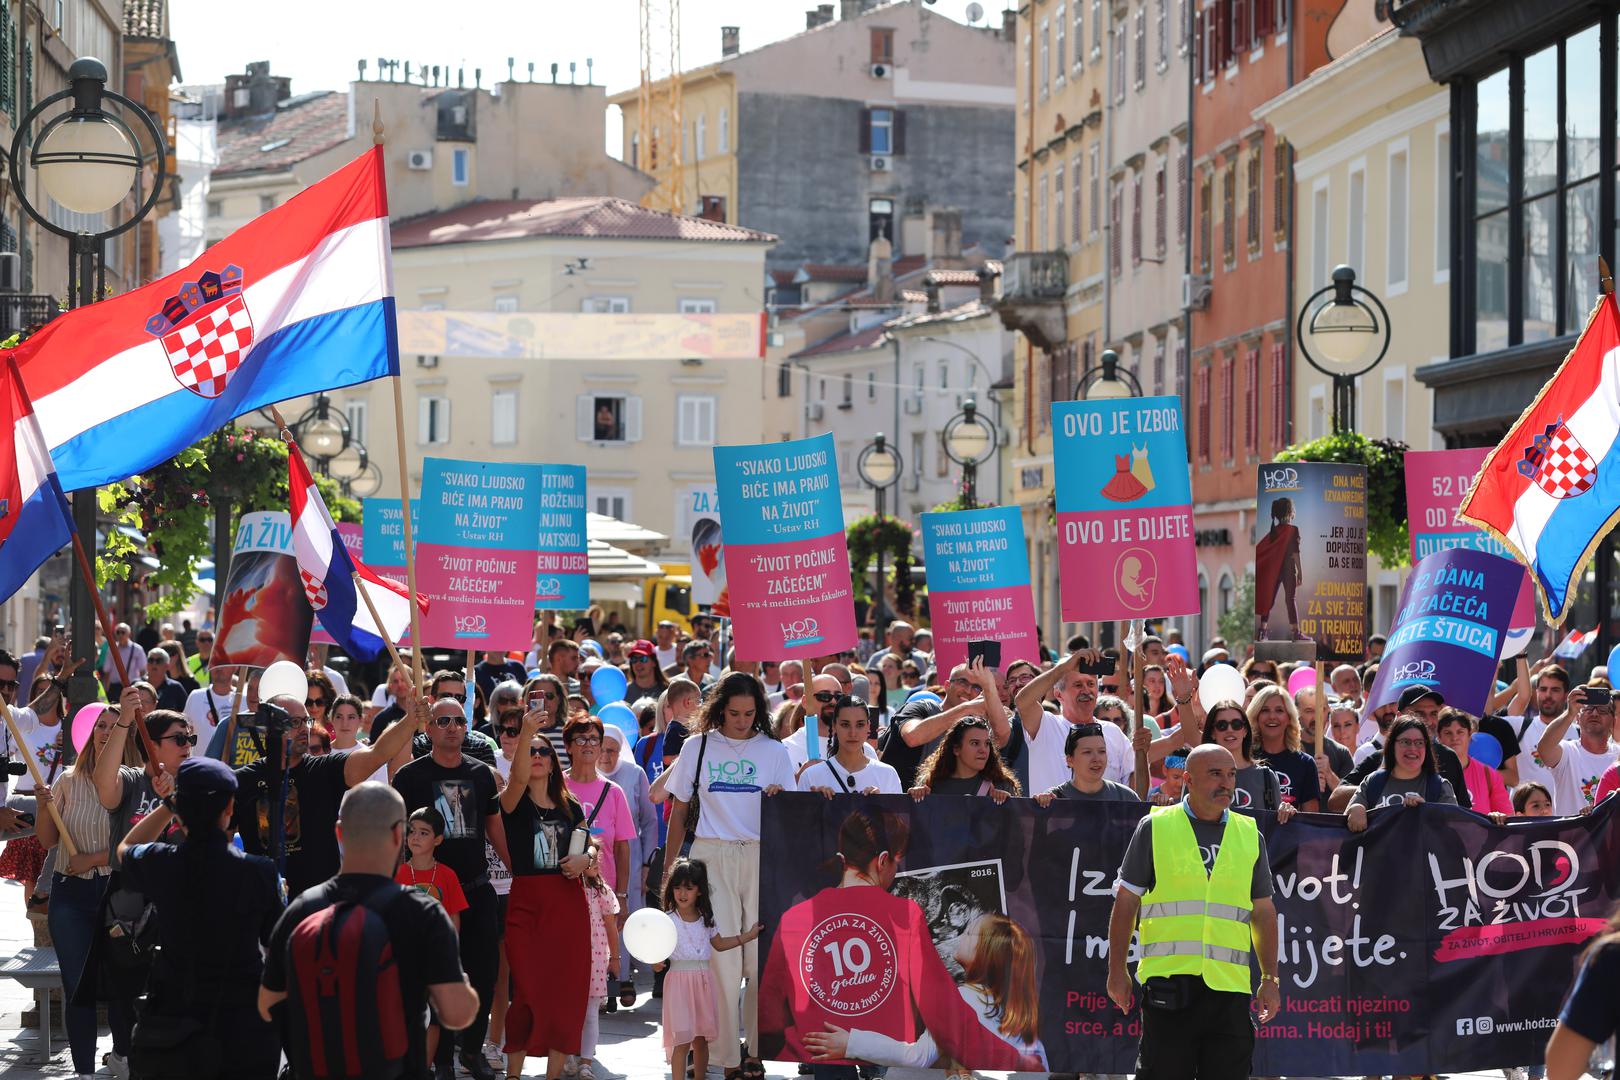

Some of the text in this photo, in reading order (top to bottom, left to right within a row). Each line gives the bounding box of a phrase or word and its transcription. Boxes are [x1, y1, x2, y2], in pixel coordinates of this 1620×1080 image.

[1063, 408, 1179, 437] OVO JE IZBOR
[736, 450, 827, 476] “SVAKO LJUDSKO
[440, 472, 526, 491] “SVAKO LJUDSKO
[1263, 467, 1298, 483] HOD
[1333, 475, 1348, 488] ONA
[742, 473, 829, 499] BIĆE IMA PRAVO
[1432, 476, 1453, 497] 52
[442, 491, 524, 510] BIĆE IMA PRAVO
[692, 492, 709, 512] ZA
[762, 499, 820, 520] NA ŽIVOT”
[455, 511, 508, 529] NA ŽIVOT”
[540, 513, 572, 528] NJINU
[773, 522, 802, 534] Ustav
[804, 519, 820, 531] RH
[964, 519, 1007, 535] LJUDSKO
[1425, 507, 1447, 528] OD
[234, 516, 295, 552] ZA ŽIV
[380, 522, 400, 535] BIĆE
[462, 530, 486, 541] Ustav
[488, 531, 504, 541] RH
[1065, 520, 1105, 545] OVO
[1110, 518, 1133, 543] JE
[1138, 515, 1190, 540] DIJETE
[1330, 526, 1344, 538] JER
[1345, 527, 1357, 539] JOJ
[539, 532, 580, 547] VATSKOJ
[936, 538, 1008, 555] BIĆE IMA PRAVO
[438, 555, 517, 574] “ŽIVOT POČINJE
[538, 555, 588, 571] ENU DJECU
[750, 547, 836, 572] “ŽIVOT POČINJE
[949, 561, 961, 573] NA
[1328, 556, 1339, 569] DA
[1341, 556, 1350, 569] SE
[956, 575, 977, 584] Ustav
[979, 573, 994, 583] RH
[1411, 567, 1485, 594] 52 DANA
[762, 599, 767, 608] 4
[769, 594, 820, 608] medicinska
[821, 589, 848, 602] fakulteta
[1314, 581, 1364, 598] JEDNAKOST
[448, 595, 493, 605] medicinska
[493, 596, 525, 606] fakulteta
[972, 597, 1013, 613] POČINJE
[1308, 597, 1364, 617] ZA SVE ŽENE
[1397, 591, 1488, 625] OD ZAČEĆA
[454, 615, 486, 628] HOD
[780, 617, 818, 635] HOD
[1300, 619, 1364, 635] OD TRENUTKA
[784, 633, 795, 641] ZA
[995, 631, 1028, 641] fakulteta
[1432, 617, 1492, 651] ŠTUCA
[1335, 636, 1364, 655] ZAČEĆA
[1393, 660, 1436, 678] HOD
[708, 758, 757, 776] HOD
[971, 868, 996, 878] 2016.
[1068, 846, 1119, 902] Iz
[1428, 840, 1580, 909] HOD
[1436, 886, 1590, 931] ZA ŽIVOT
[805, 917, 891, 972] GENERACIJA ZA ŽIVOT
[1448, 939, 1462, 951] ZA
[1493, 932, 1531, 944] OBITELJ
[1532, 931, 1537, 940] I
[1538, 923, 1587, 938] HRVATSKU
[823, 937, 871, 977] 10
[809, 966, 893, 1011] 2016. HOD ZA ŽIVOT 2025.
[831, 971, 877, 996] godina
[1066, 991, 1108, 1012] Prije
[1286, 995, 1341, 1013] kucati
[1347, 995, 1411, 1016] njezino
[1065, 1020, 1108, 1038] srce,
[1112, 1022, 1123, 1036] a
[1307, 1021, 1361, 1043] Hodaj
[1365, 1021, 1370, 1039] i
[1374, 1021, 1392, 1039] ti!
